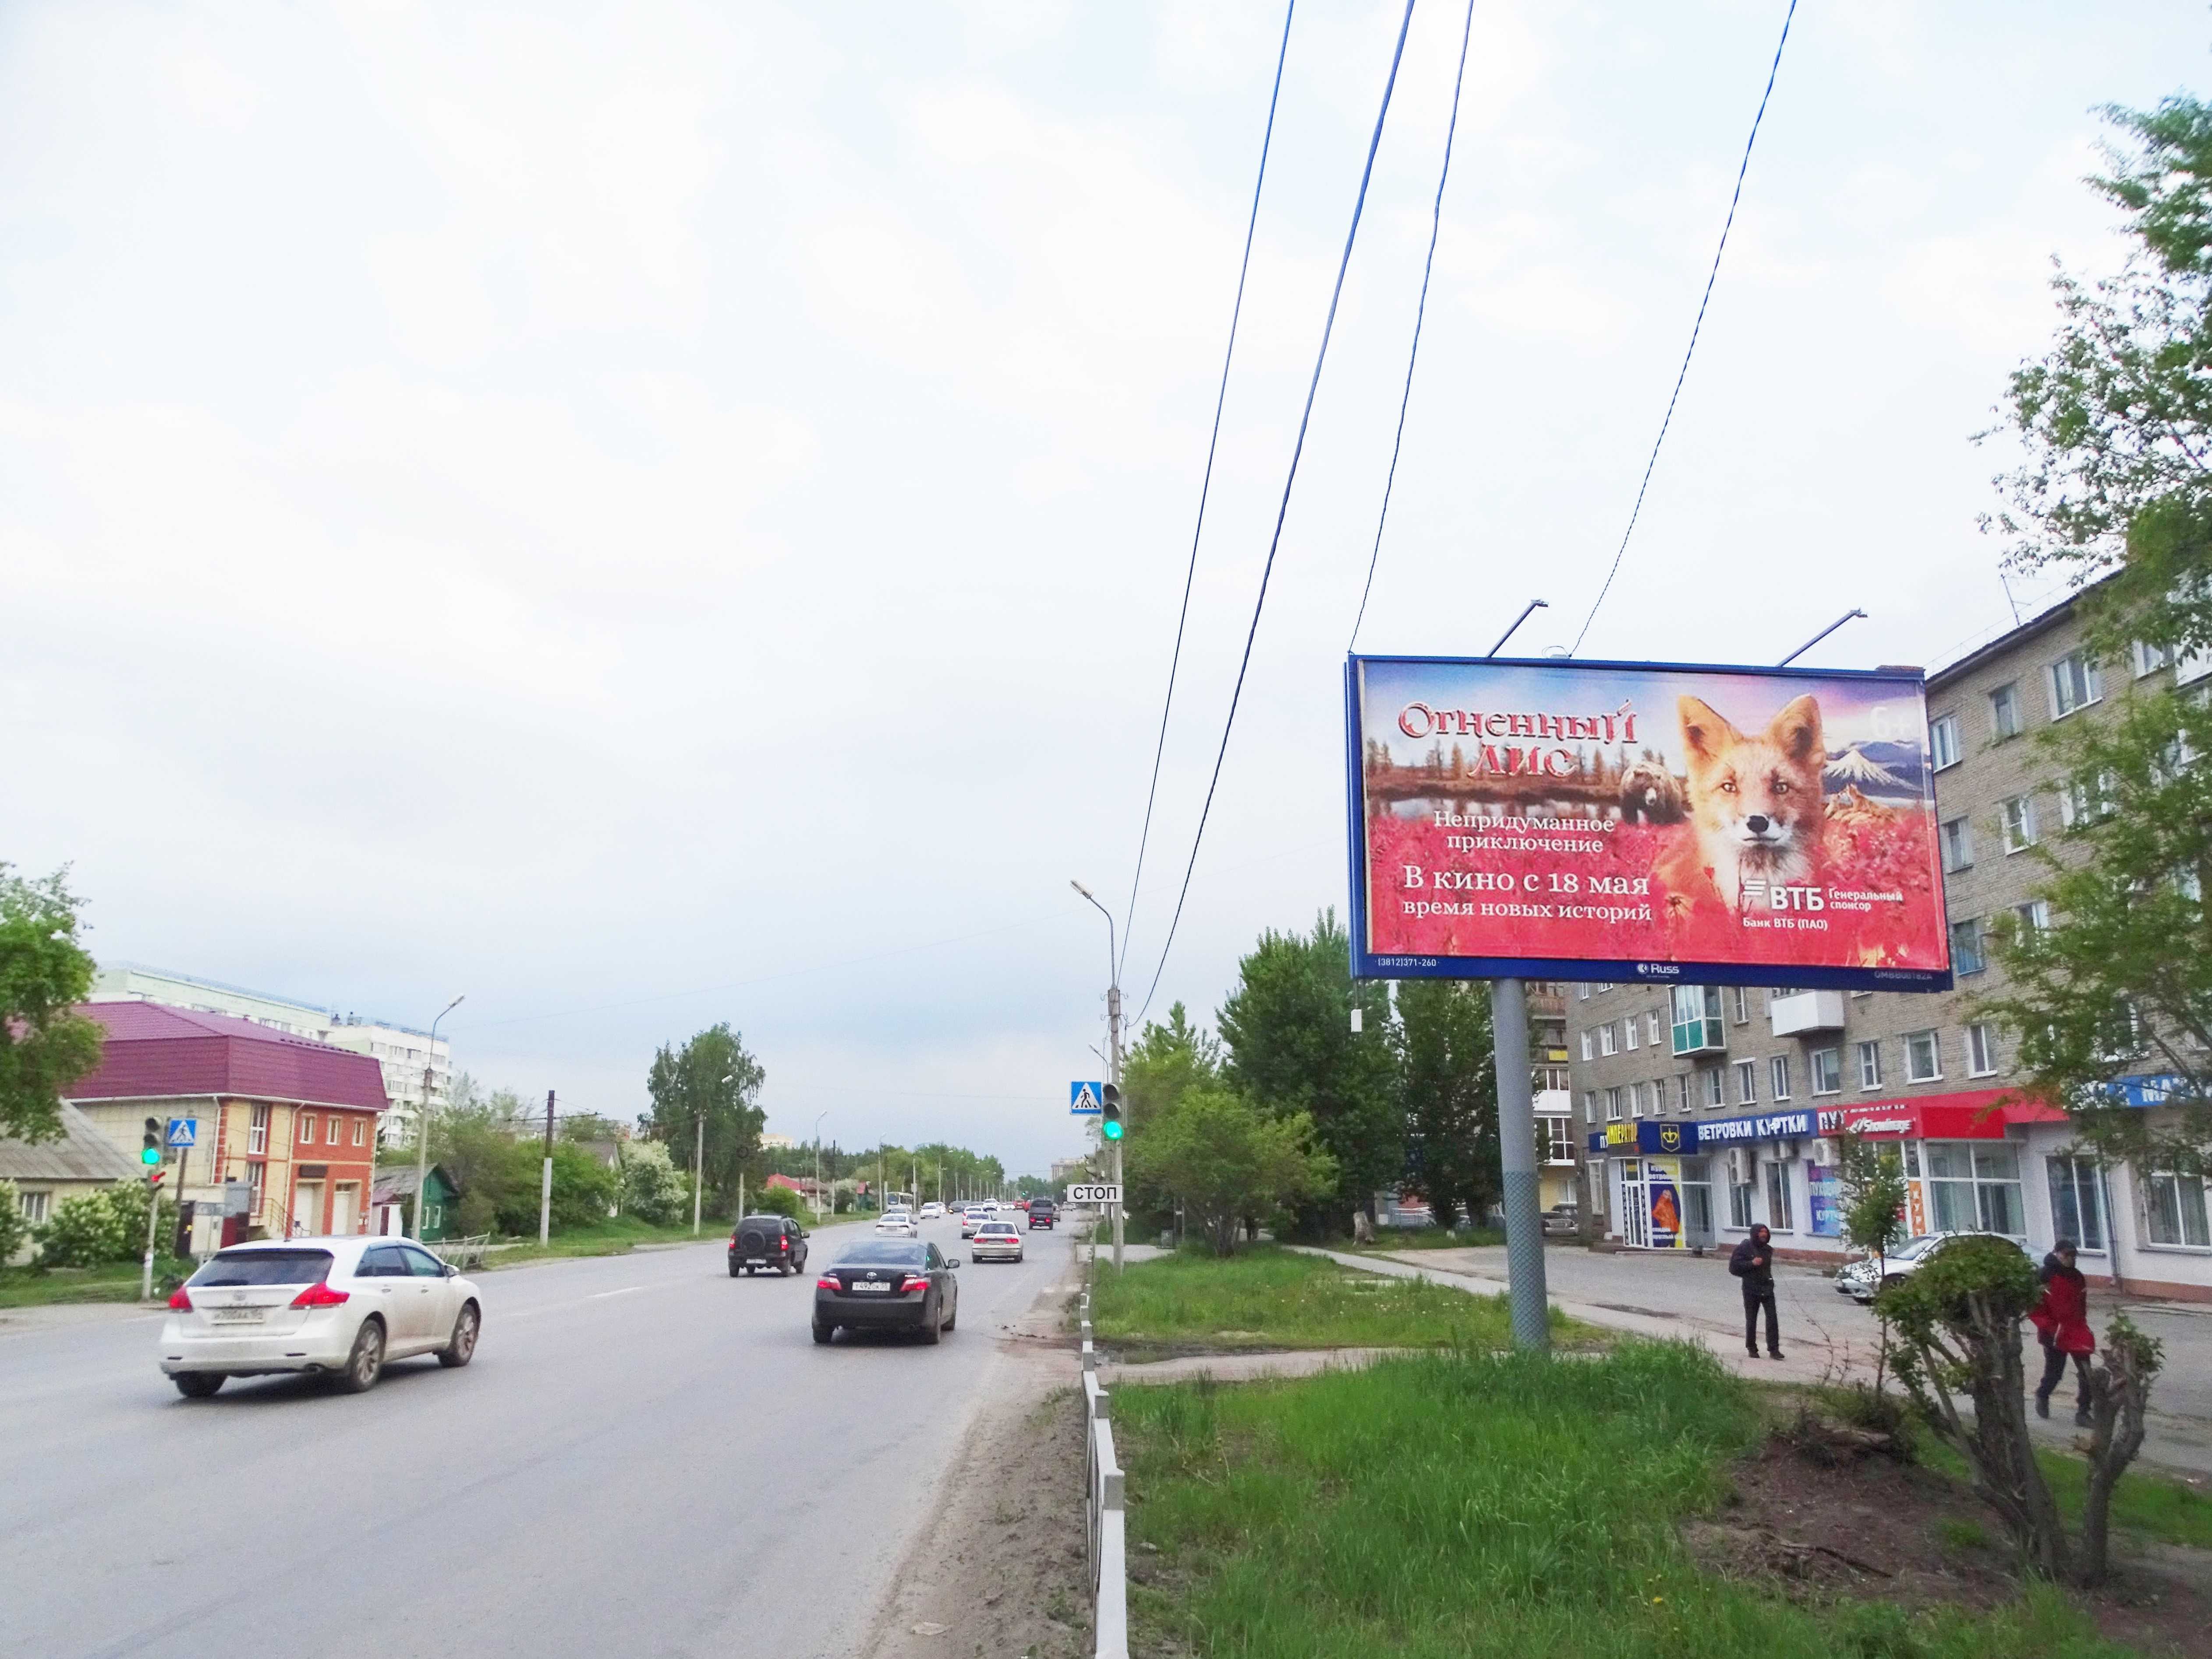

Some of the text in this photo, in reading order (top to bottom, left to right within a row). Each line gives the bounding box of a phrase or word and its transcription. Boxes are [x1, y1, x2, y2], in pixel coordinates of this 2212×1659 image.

[1433, 810, 1614, 833] Непридуманное
[1447, 835, 1603, 853] приключение
[1403, 865, 1649, 895] В кино с 18 мая
[1770, 886, 1824, 911] ВТБ
[1829, 888, 1903, 902] Генеральный
[1403, 901, 1652, 923] время новых историй
[1830, 902, 1871, 912] спонсор
[1743, 917, 1828, 931] Банк ВТБ (ПАО)
[1378, 958, 1436, 967] (3812)371-260
[1651, 964, 1679, 973] Russ
[1698, 1114, 1807, 1140] ВЕТРОВКИ КУРТКИ
[1073, 1186, 1117, 1199] СТОП
